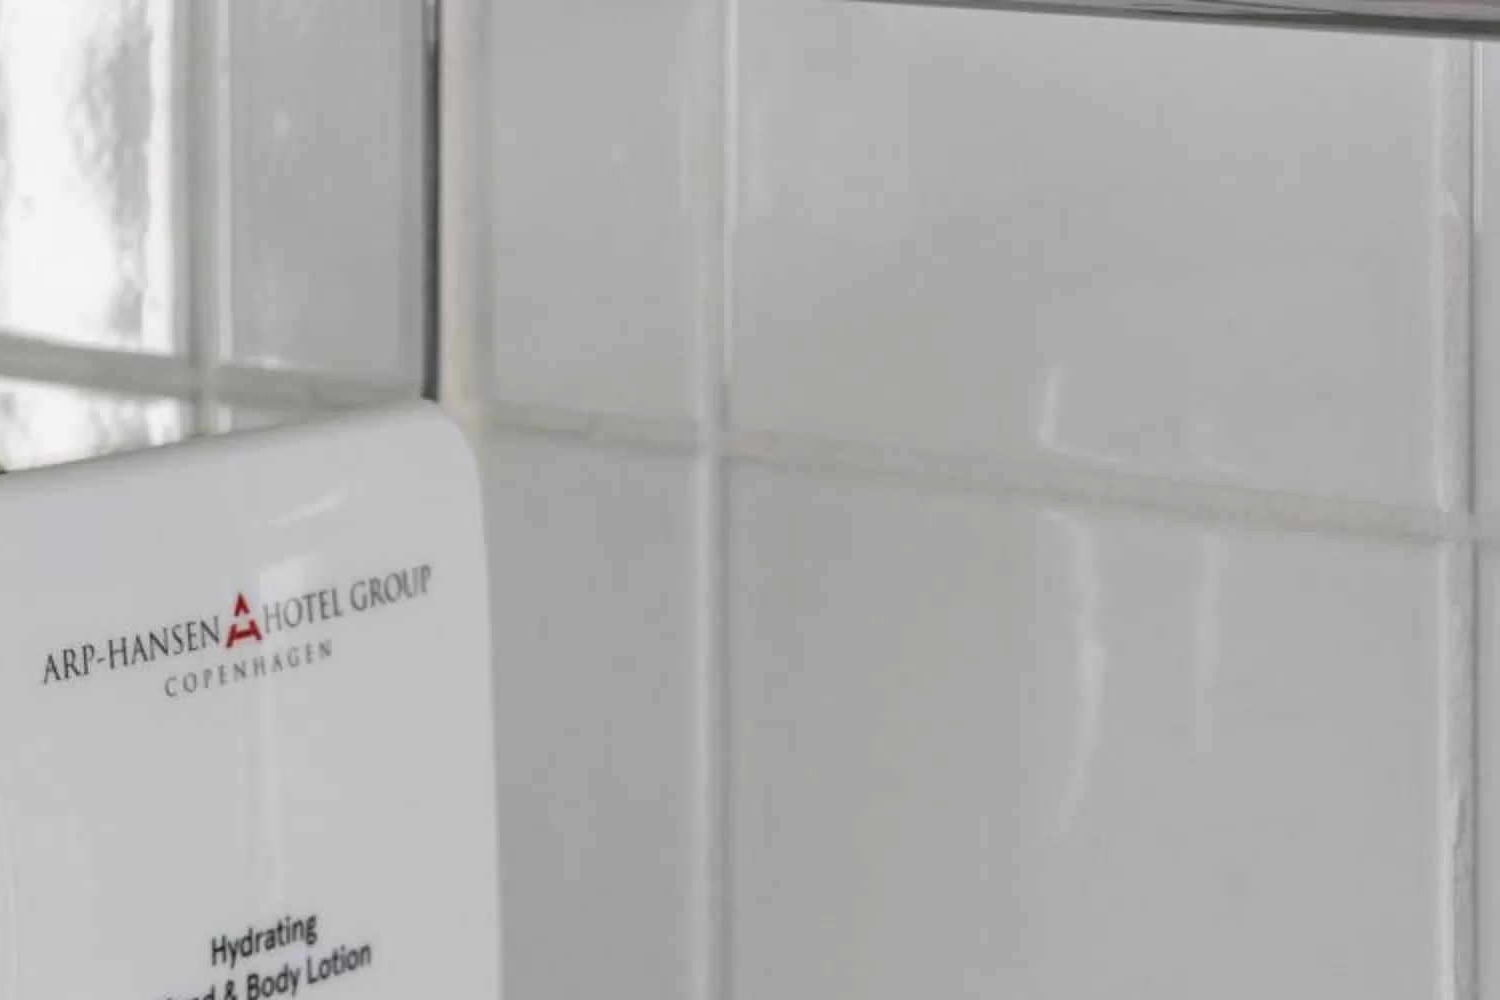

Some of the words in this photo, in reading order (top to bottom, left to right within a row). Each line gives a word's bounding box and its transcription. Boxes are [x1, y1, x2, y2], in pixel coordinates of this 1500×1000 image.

[42, 615, 220, 685] ARP-HANSEN
[263, 588, 344, 634] HOTEL
[349, 564, 432, 612] GROUP
[163, 640, 333, 698] COPENHAGEN
[210, 914, 318, 969] Hydrating
[306, 942, 372, 985] Lotion
